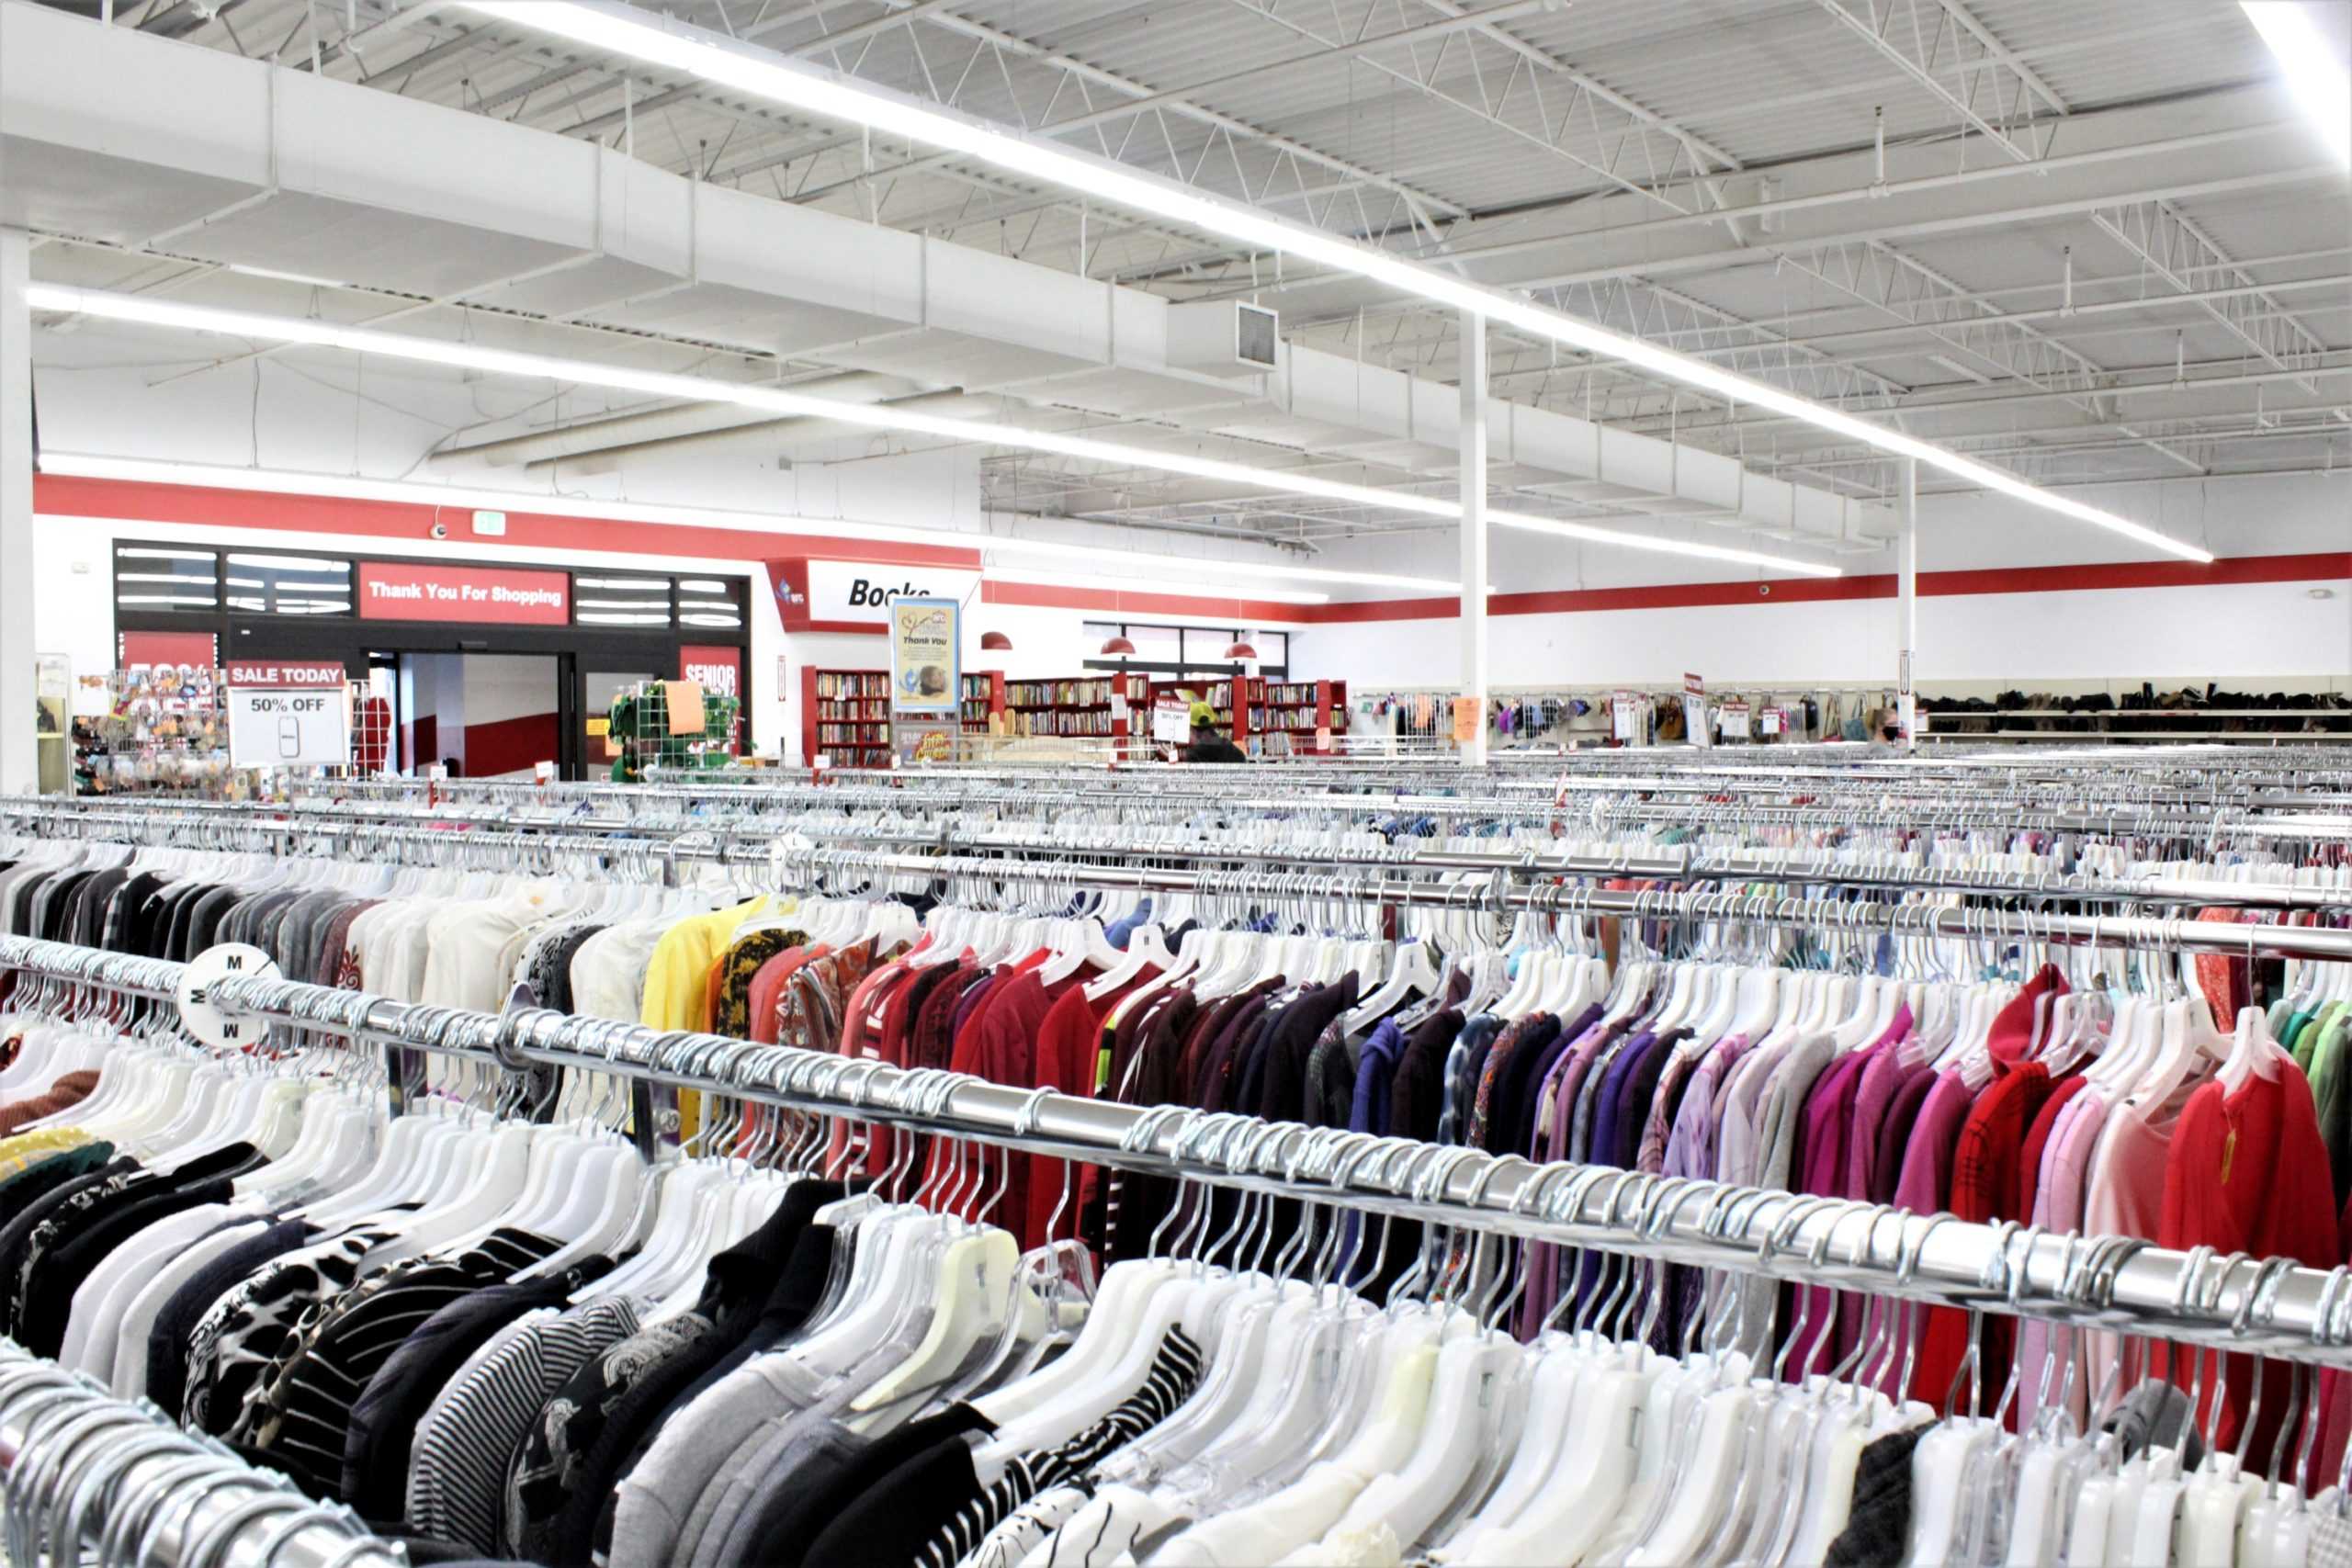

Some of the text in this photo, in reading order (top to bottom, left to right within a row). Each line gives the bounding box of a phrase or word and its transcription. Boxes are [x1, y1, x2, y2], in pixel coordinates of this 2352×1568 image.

[368, 581, 561, 607] Thank You For Shopping
[903, 636, 947, 646] Thank You
[232, 667, 279, 683] SALE
[281, 668, 340, 683] TODAY
[685, 664, 736, 687] SENIOR
[251, 698, 325, 712] 50% OFF
[227, 955, 242, 970] M
[190, 989, 206, 1004] M
[223, 1023, 239, 1038] M
